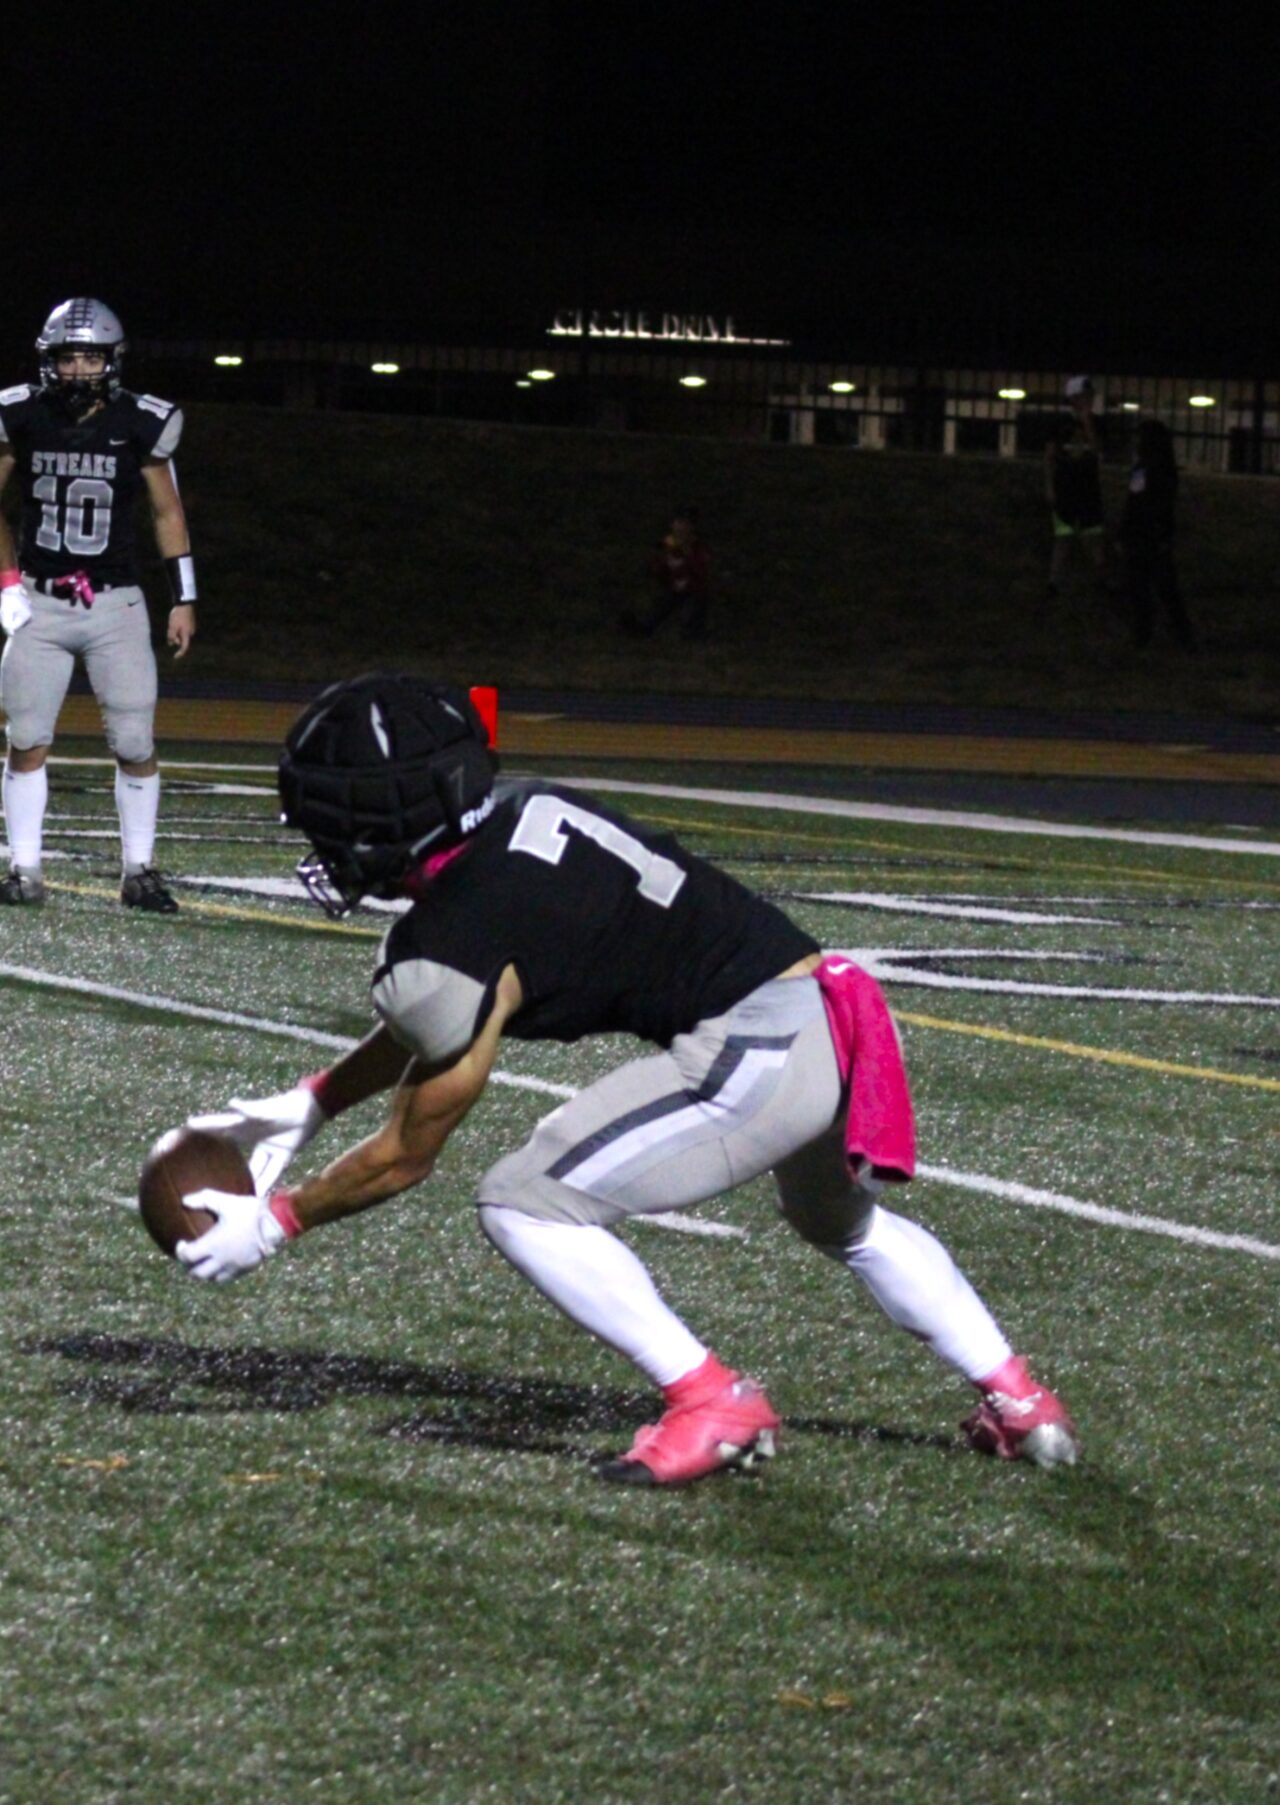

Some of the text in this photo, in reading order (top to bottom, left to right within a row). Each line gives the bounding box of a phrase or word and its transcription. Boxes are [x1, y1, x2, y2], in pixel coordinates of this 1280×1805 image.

[31, 451, 117, 479] STREAKS
[33, 475, 113, 555] 10
[508, 794, 687, 909] 7
